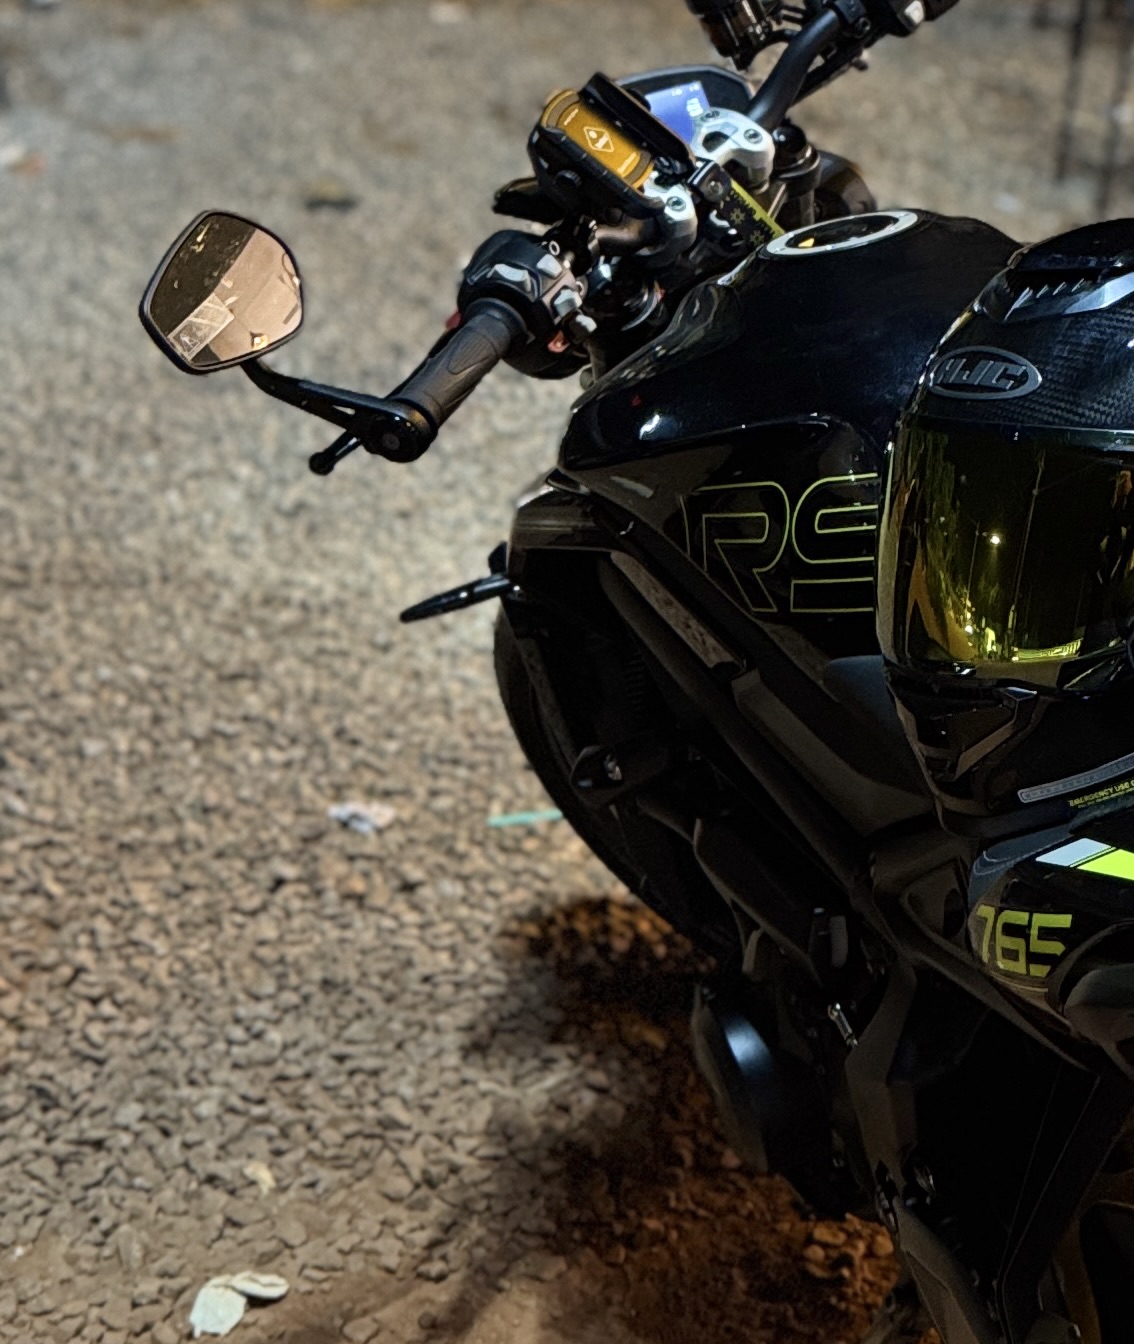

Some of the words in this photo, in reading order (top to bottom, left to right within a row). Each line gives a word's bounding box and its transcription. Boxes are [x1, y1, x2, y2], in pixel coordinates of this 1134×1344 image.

[931, 358, 1027, 391] HJC
[680, 472, 878, 613] RS
[976, 904, 1073, 978] 765
